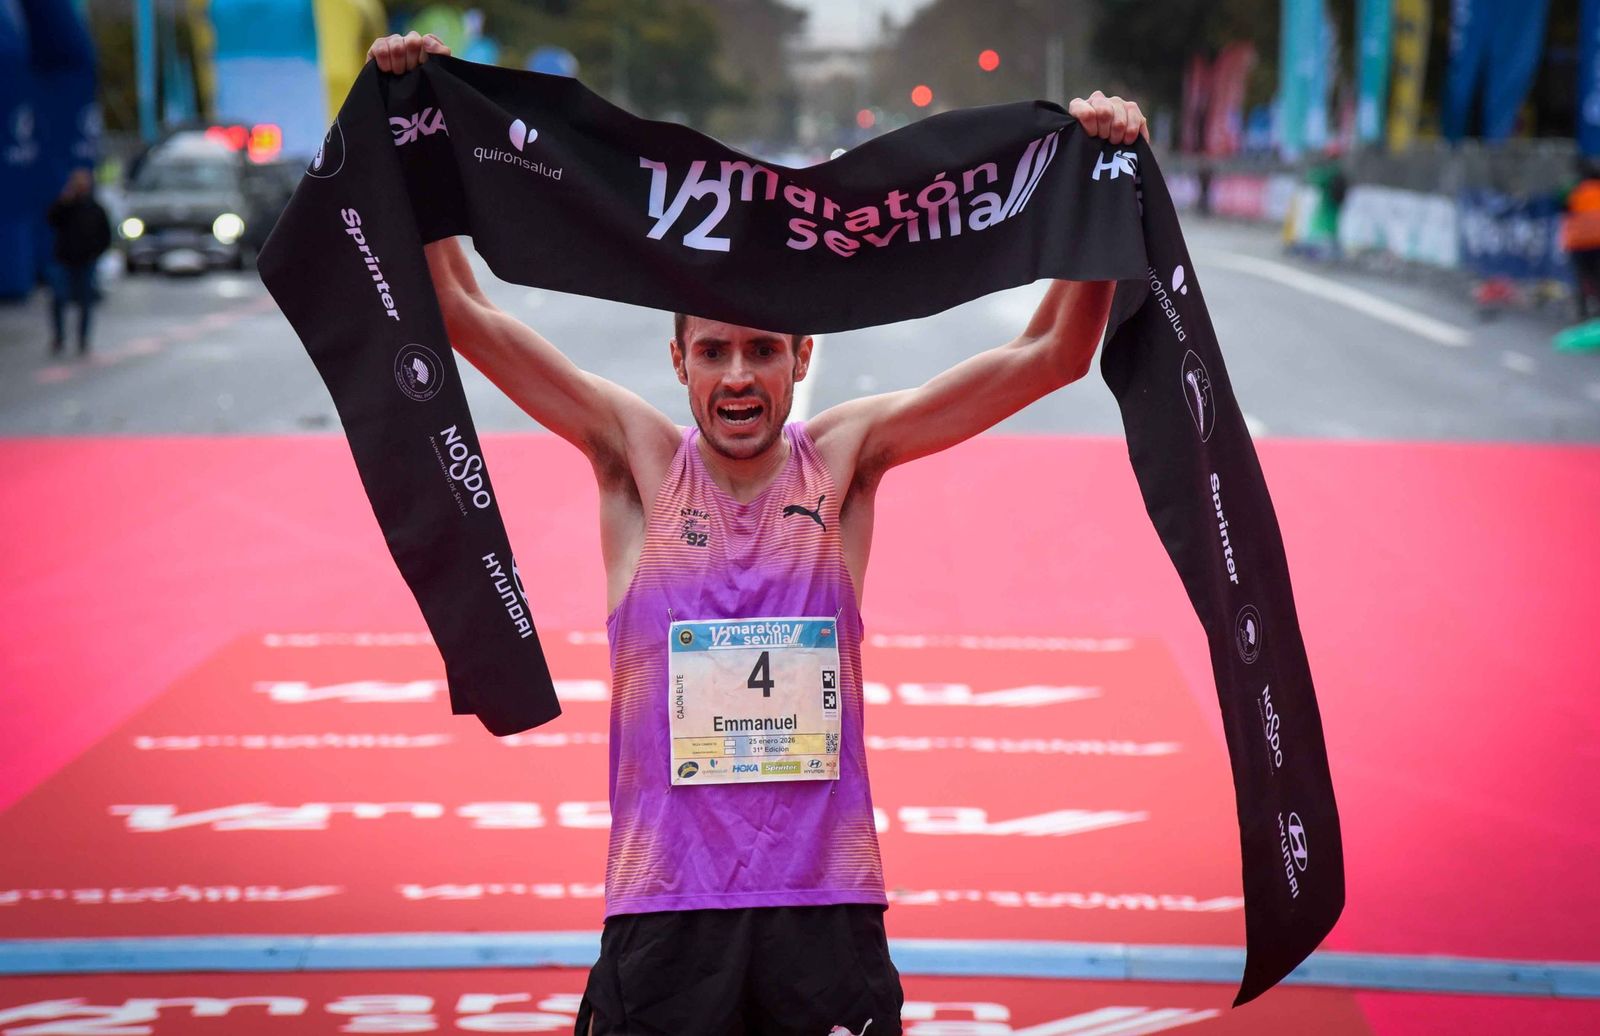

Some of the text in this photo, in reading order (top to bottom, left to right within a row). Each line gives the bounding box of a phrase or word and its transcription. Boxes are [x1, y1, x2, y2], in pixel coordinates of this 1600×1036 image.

[388, 107, 450, 146] OKA
[720, 161, 999, 232] maratón
[786, 193, 1005, 258] sevilla
[340, 207, 400, 322] Sprinter
[1210, 472, 1239, 585] Sprinter
[482, 552, 533, 639] HYUNDAI
[726, 621, 791, 635] maratón
[743, 632, 792, 645] sevilla
[747, 651, 775, 697] 4
[713, 714, 798, 732] Emmanuel
[732, 764, 759, 773] HOKA
[1278, 813, 1300, 899] HYUNDAI
